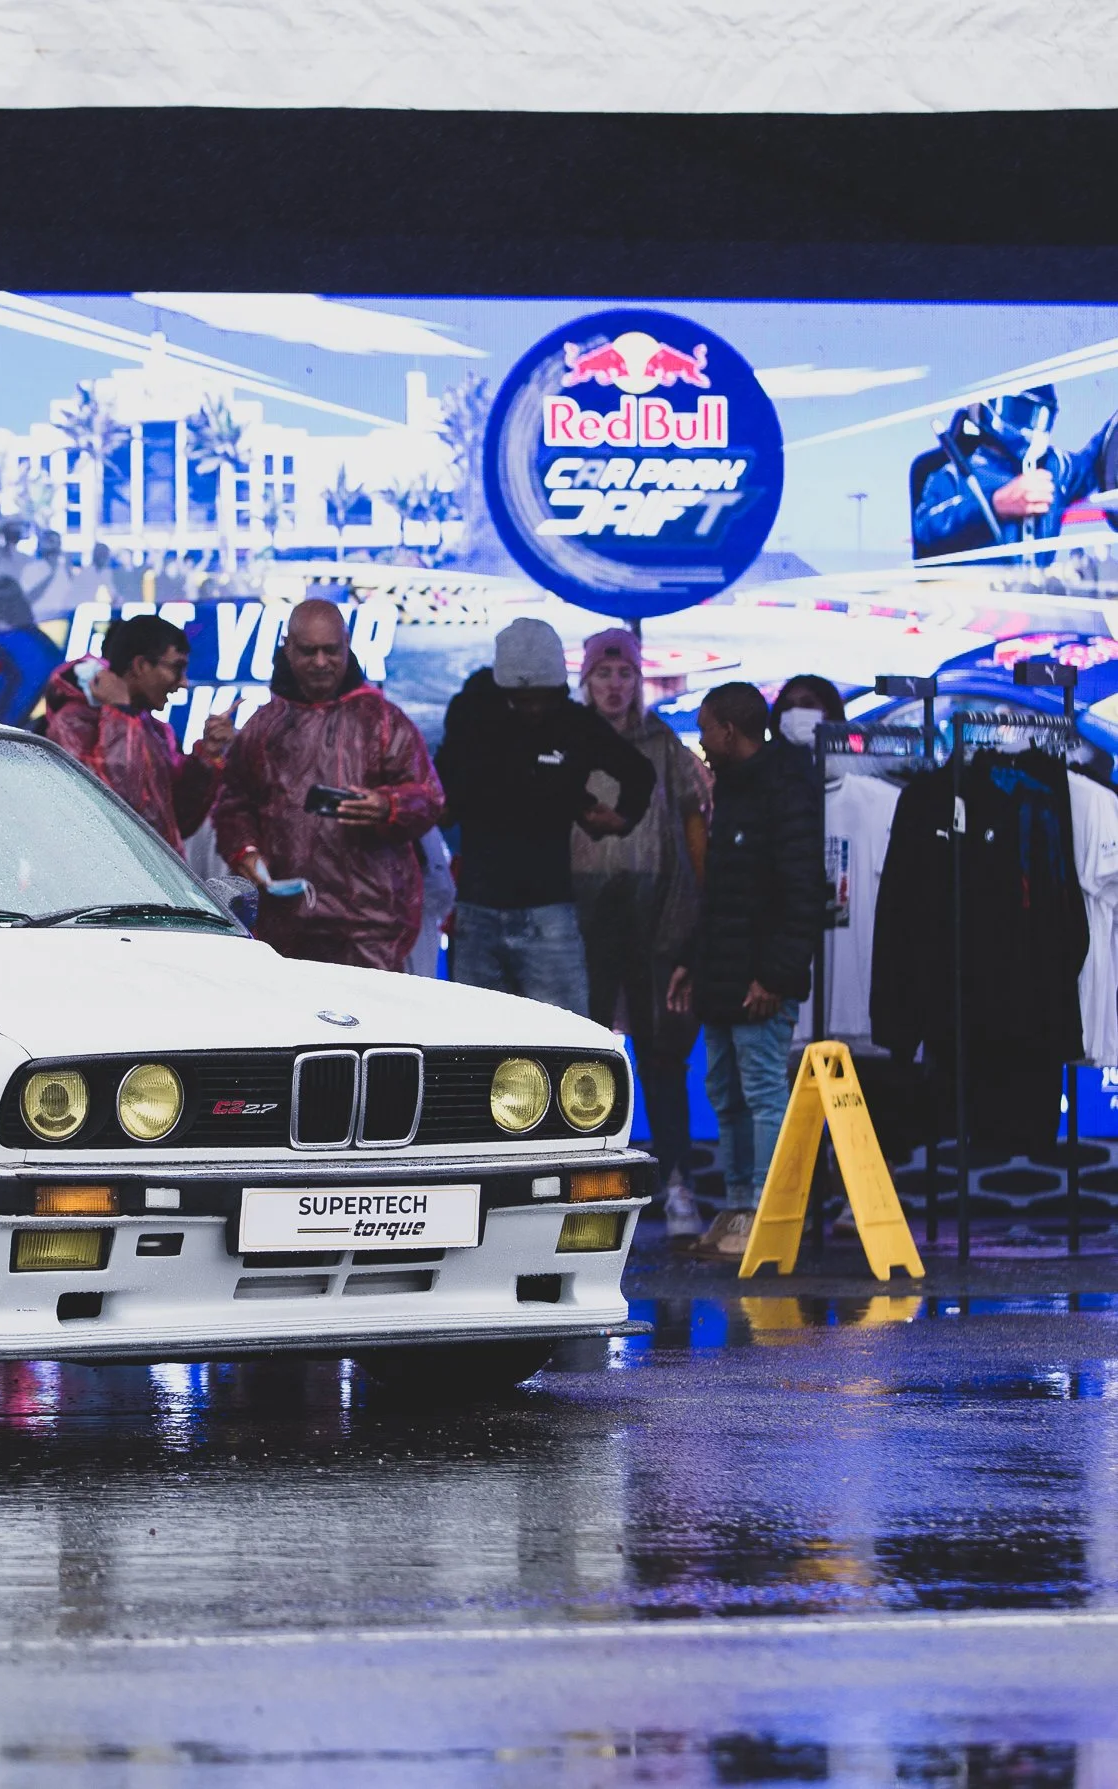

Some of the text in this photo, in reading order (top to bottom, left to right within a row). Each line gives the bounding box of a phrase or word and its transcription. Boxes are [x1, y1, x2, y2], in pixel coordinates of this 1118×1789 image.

[550, 401, 722, 442] Red Bull
[298, 1195, 428, 1216] SUPERTECH
[353, 1219, 426, 1241] torque
